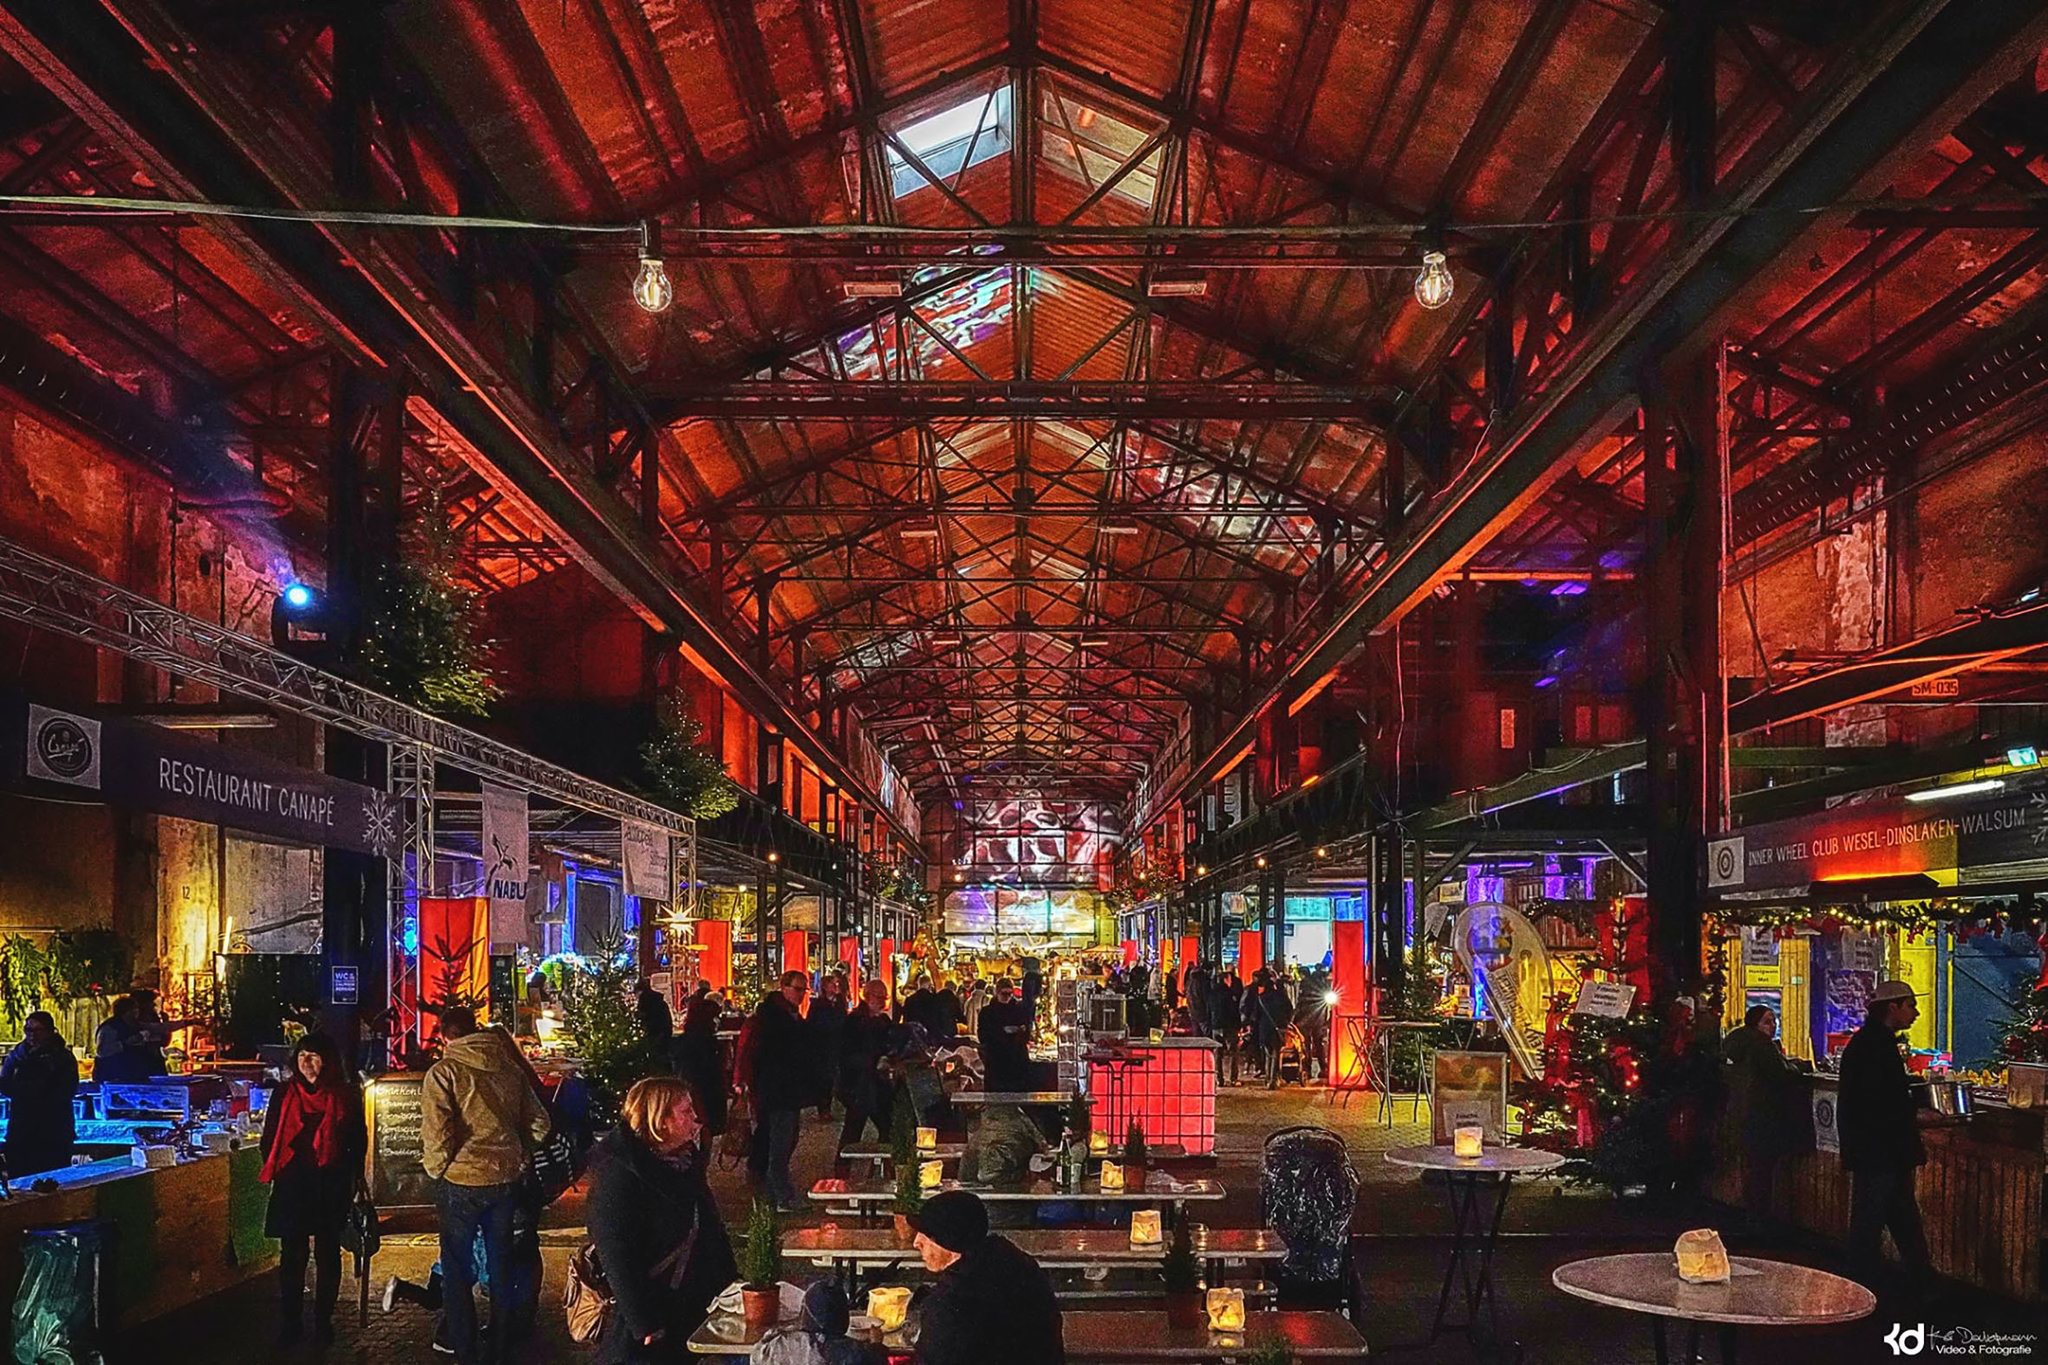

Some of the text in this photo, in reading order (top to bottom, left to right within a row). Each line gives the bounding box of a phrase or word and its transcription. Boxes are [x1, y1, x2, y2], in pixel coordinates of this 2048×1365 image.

[1913, 681, 1958, 694] SM-035
[159, 757, 336, 826] RESTAURANT CANAPÉ
[1748, 807, 2026, 867] INNER WHEEL CLUB WESEL-DINSLAKEN-WALSUM
[182, 885, 191, 900] 12
[493, 879, 528, 900] NABU
[335, 972, 348, 980] WC
